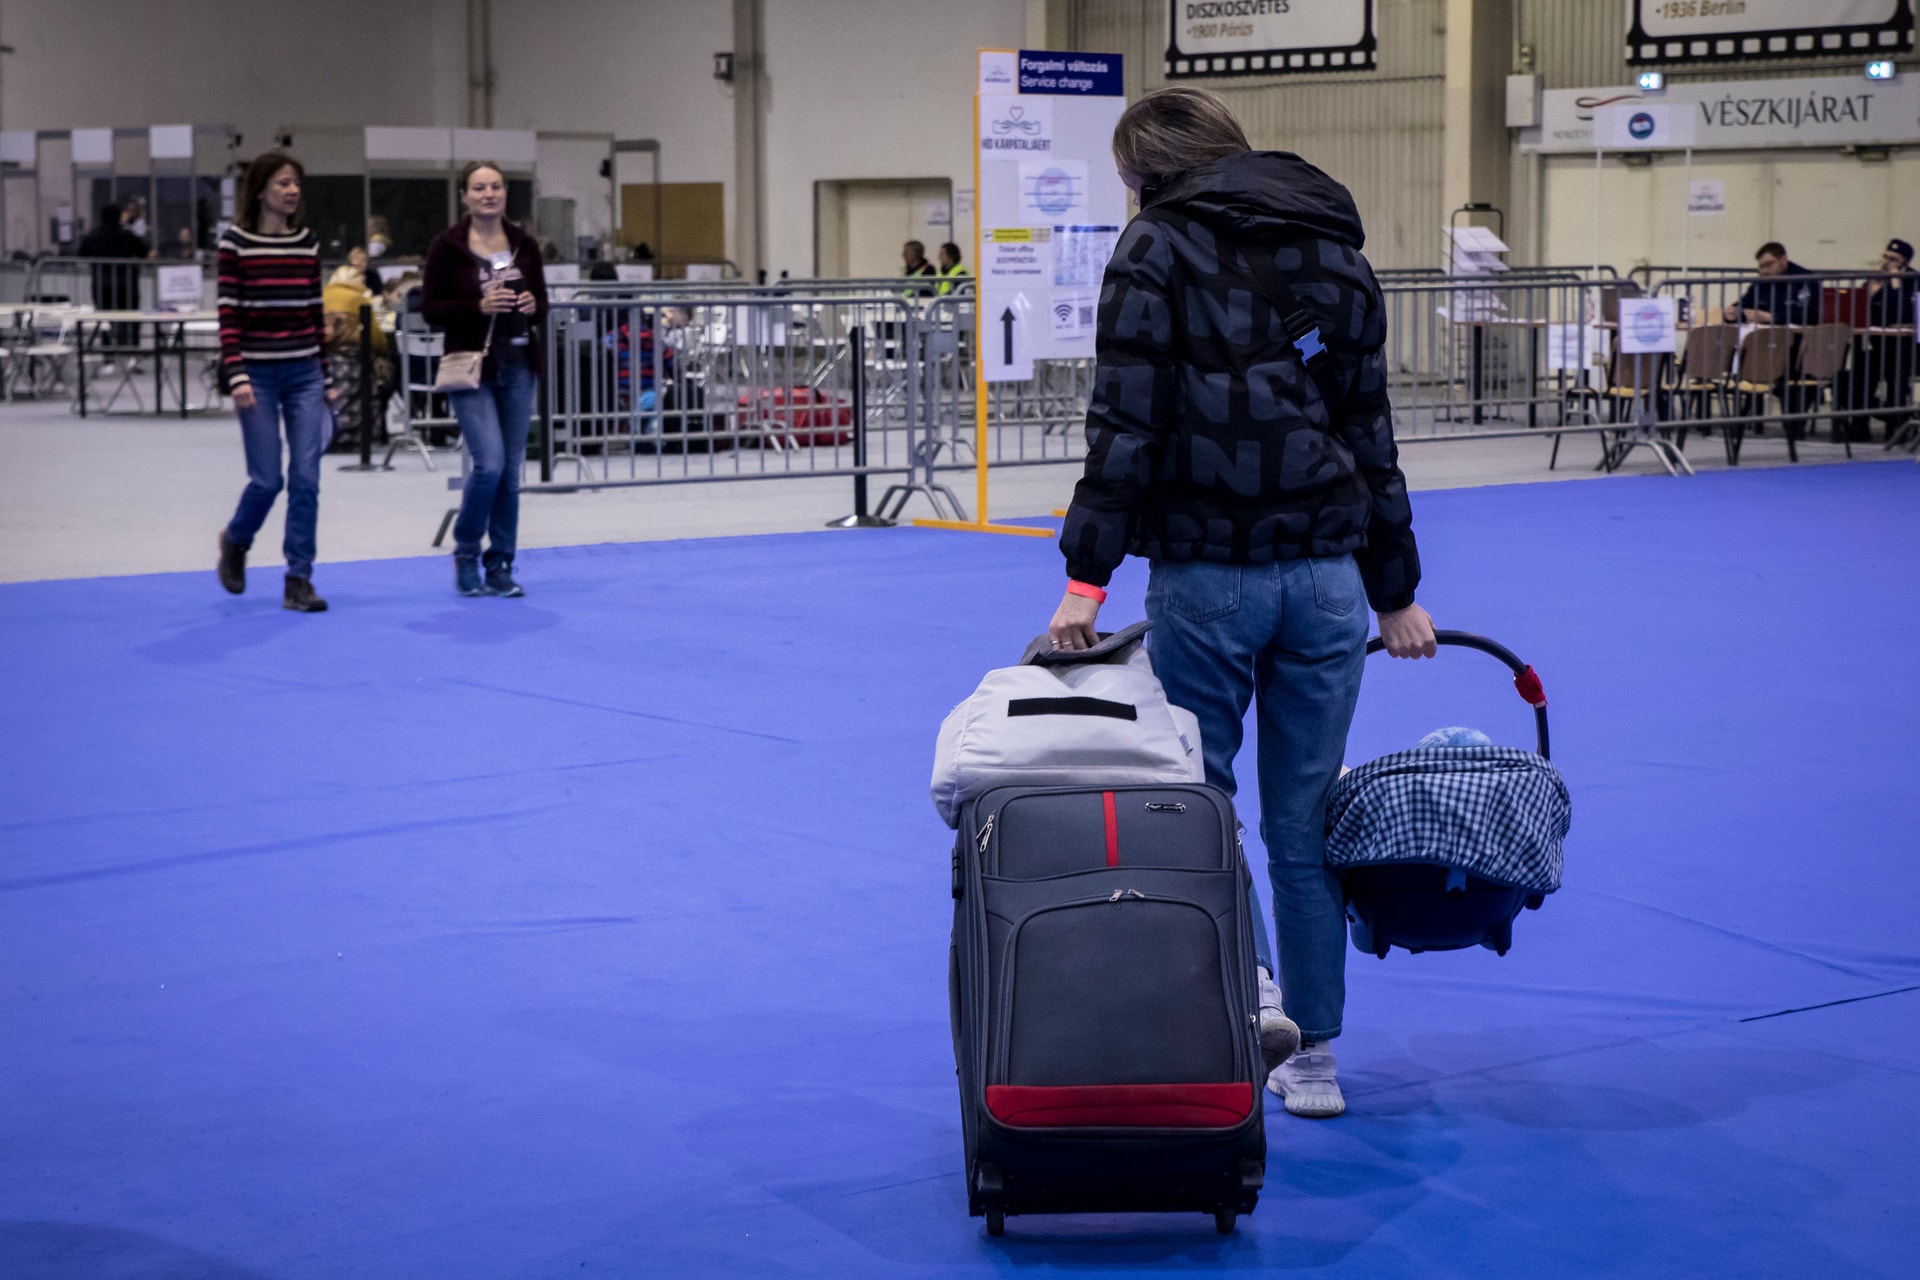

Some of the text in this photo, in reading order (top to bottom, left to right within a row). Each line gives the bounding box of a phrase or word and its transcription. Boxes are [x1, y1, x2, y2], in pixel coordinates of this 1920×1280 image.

[1020, 58, 1109, 74] Forgalmi változás
[1020, 74, 1094, 92] Service change
[1699, 91, 1875, 129] VÉSZKIJÁRAT
